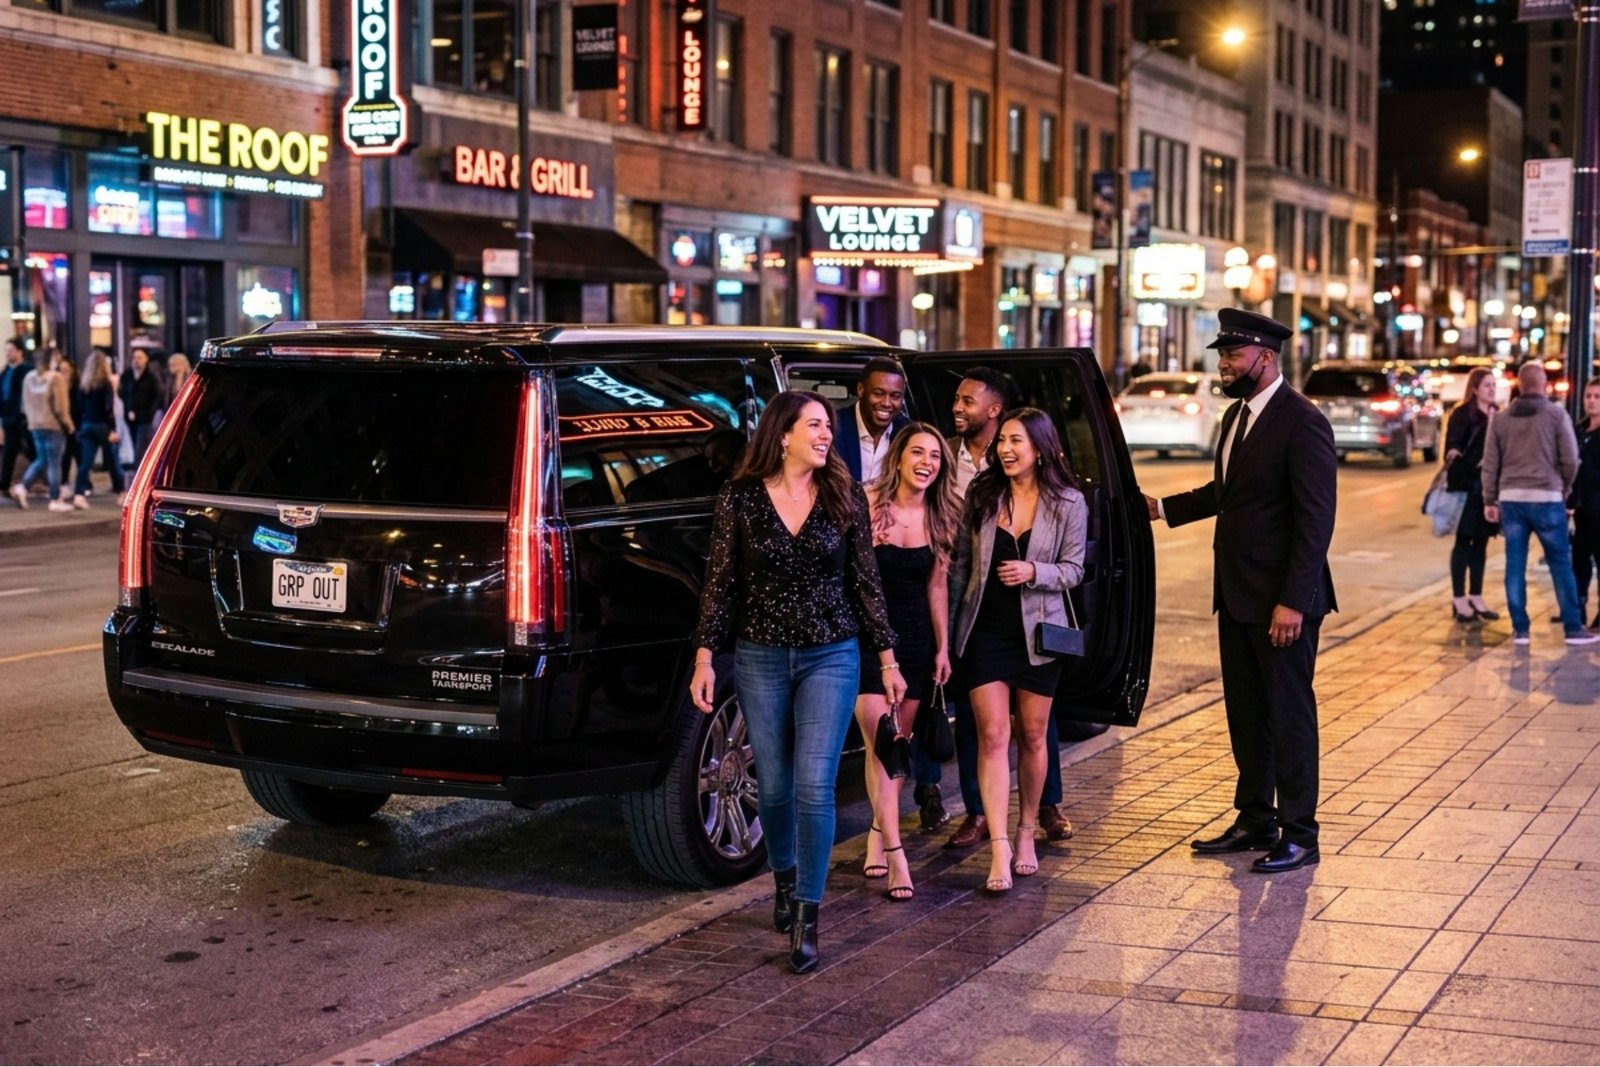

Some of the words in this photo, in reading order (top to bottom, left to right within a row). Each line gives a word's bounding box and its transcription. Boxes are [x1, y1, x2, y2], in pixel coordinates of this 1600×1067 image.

[683, 30, 702, 125] LOUNGE
[146, 111, 222, 166] THE
[228, 122, 329, 177] ROOF
[455, 144, 507, 189] BAR
[530, 156, 595, 200] GRILL
[815, 205, 935, 234] VELVET
[828, 233, 921, 252] LOUNGE
[278, 573, 305, 598] GRP
[312, 576, 340, 601] OUT
[431, 670, 493, 684] PREMIER
